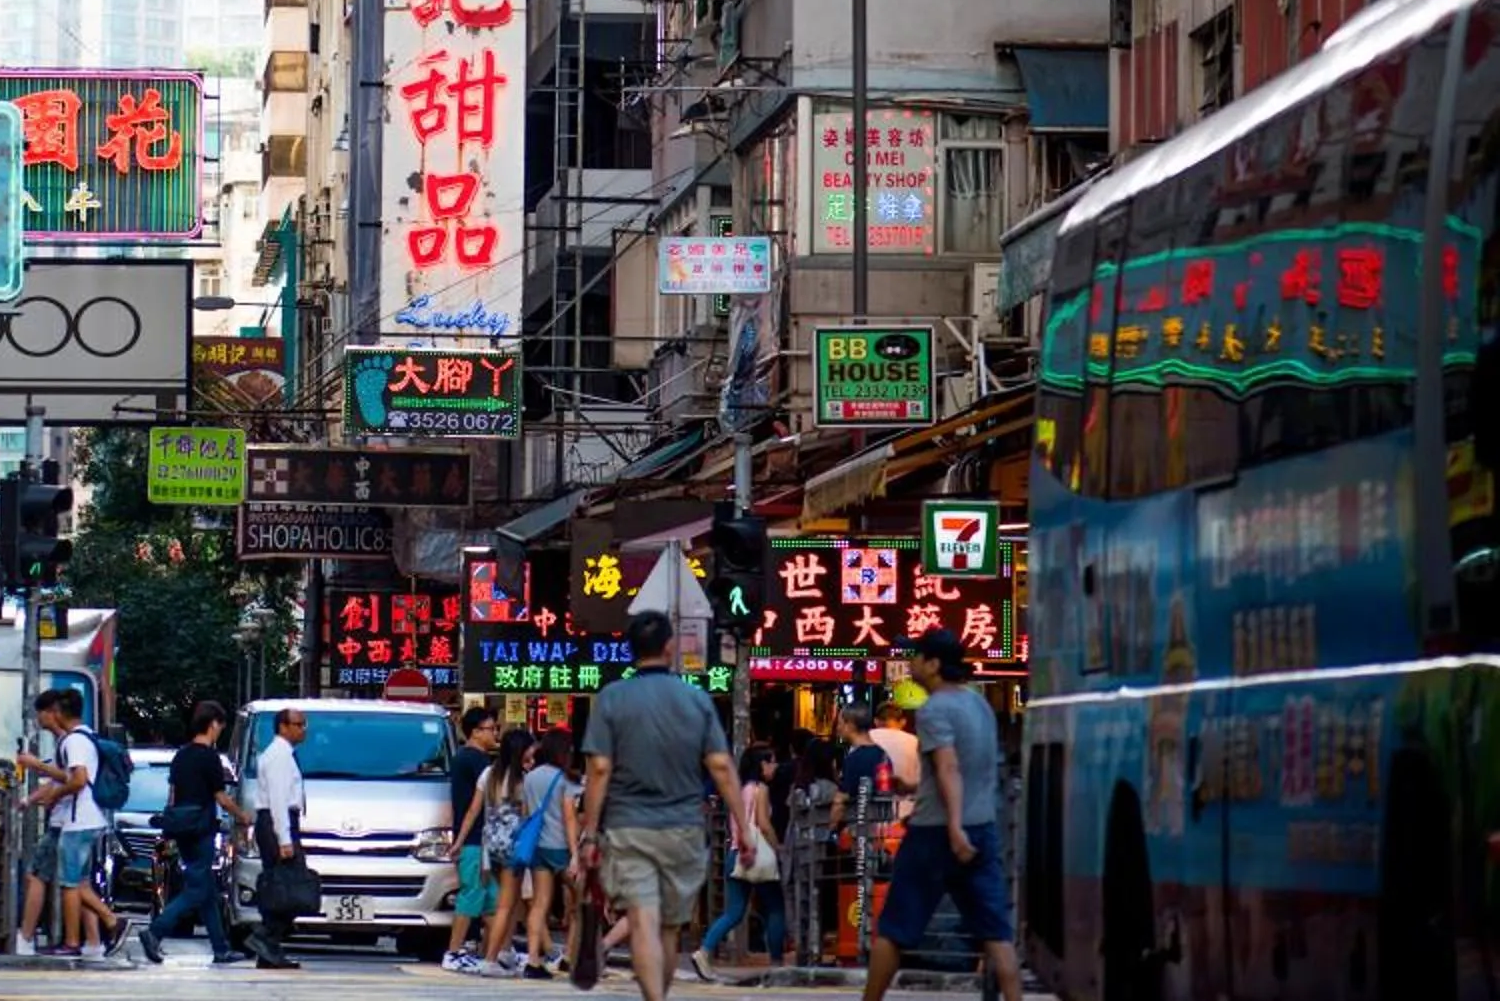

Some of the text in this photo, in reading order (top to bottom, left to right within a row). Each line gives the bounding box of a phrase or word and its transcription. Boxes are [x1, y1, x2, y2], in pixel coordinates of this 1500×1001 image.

[875, 151, 905, 165] MEI
[823, 172, 927, 187] BEATY SHOP
[828, 338, 867, 360] BB
[388, 356, 514, 397] 大腳丫
[828, 363, 920, 381] HOUSE
[409, 413, 514, 430] 3526 0672
[479, 641, 519, 662] TAI
[494, 665, 603, 689] 政府註冊
